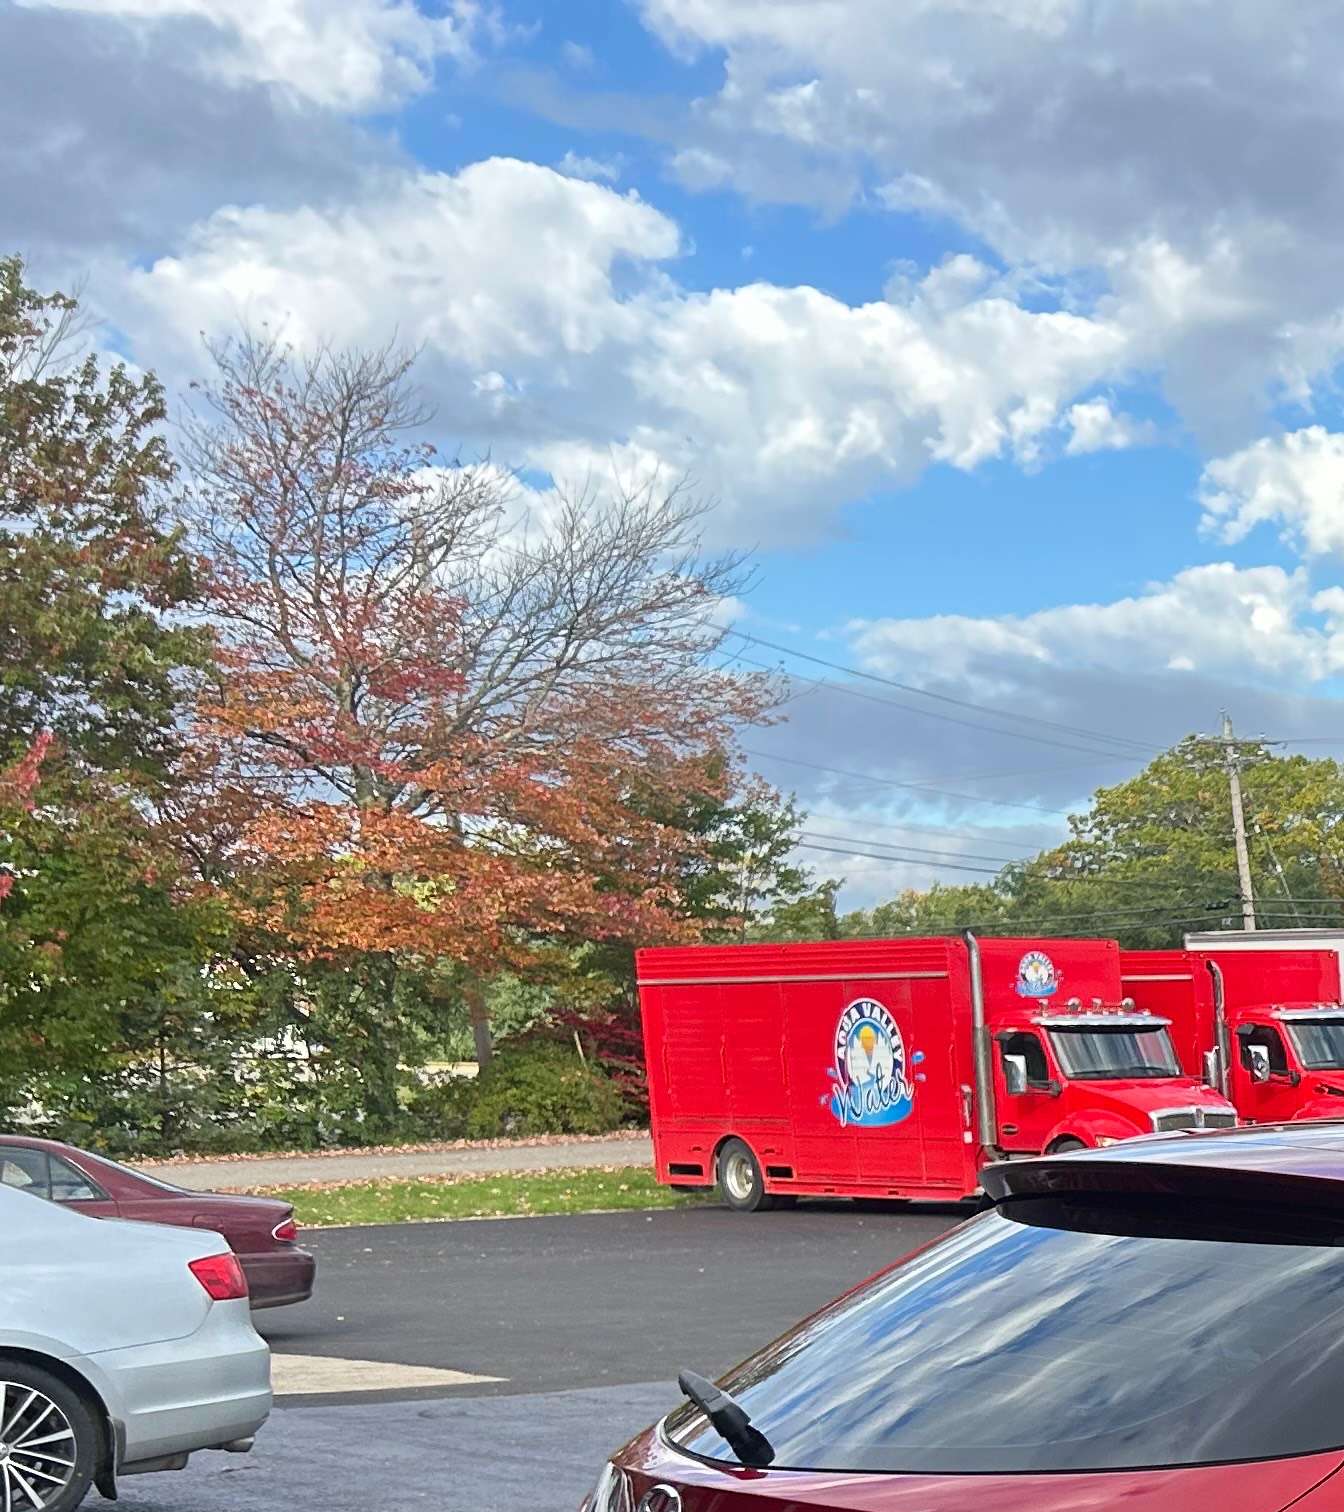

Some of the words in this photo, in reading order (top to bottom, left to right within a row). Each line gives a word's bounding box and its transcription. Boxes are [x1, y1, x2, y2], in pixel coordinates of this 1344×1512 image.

[837, 1006, 860, 1060] AQUA
[862, 1002, 903, 1061] VALLEY
[833, 1062, 914, 1127] Water
